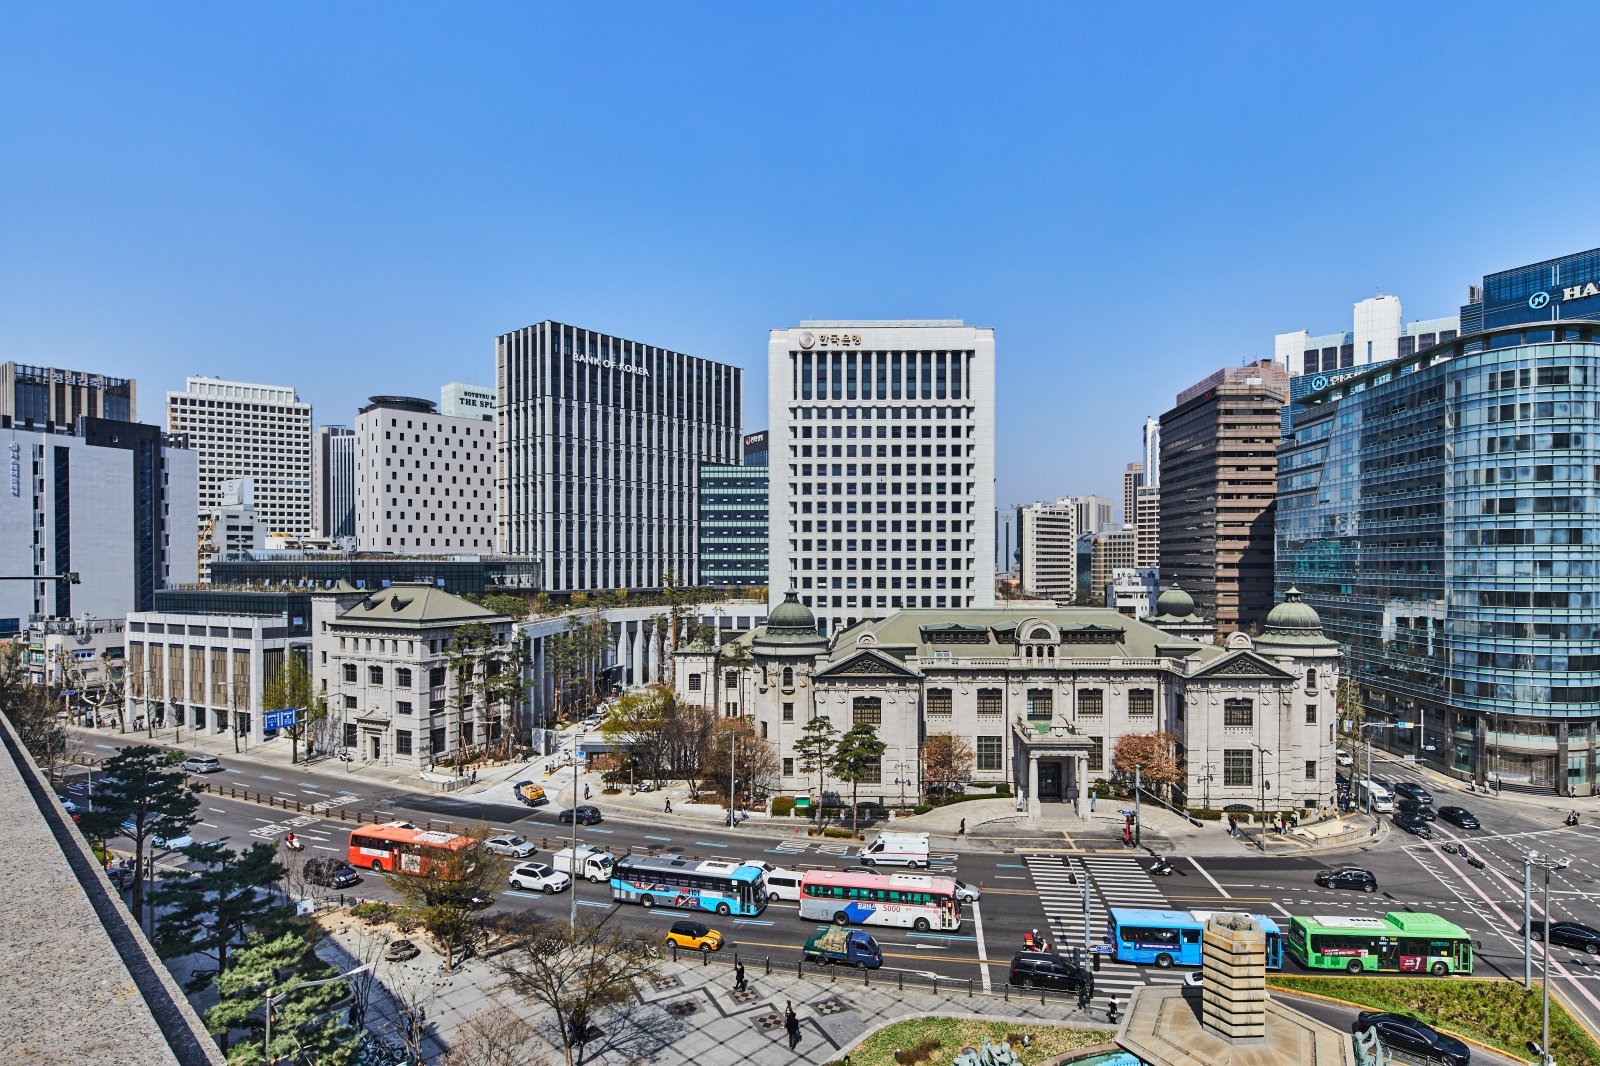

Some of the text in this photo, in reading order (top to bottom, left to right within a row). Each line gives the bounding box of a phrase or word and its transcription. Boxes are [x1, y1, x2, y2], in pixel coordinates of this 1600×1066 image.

[1563, 281, 1600, 301] HA
[819, 333, 862, 346] 한국은행
[572, 352, 650, 377] BANK OF KOREA
[463, 391, 490, 400] SOTETSU
[459, 397, 497, 410] THE SPL
[883, 904, 900, 913] 5000
